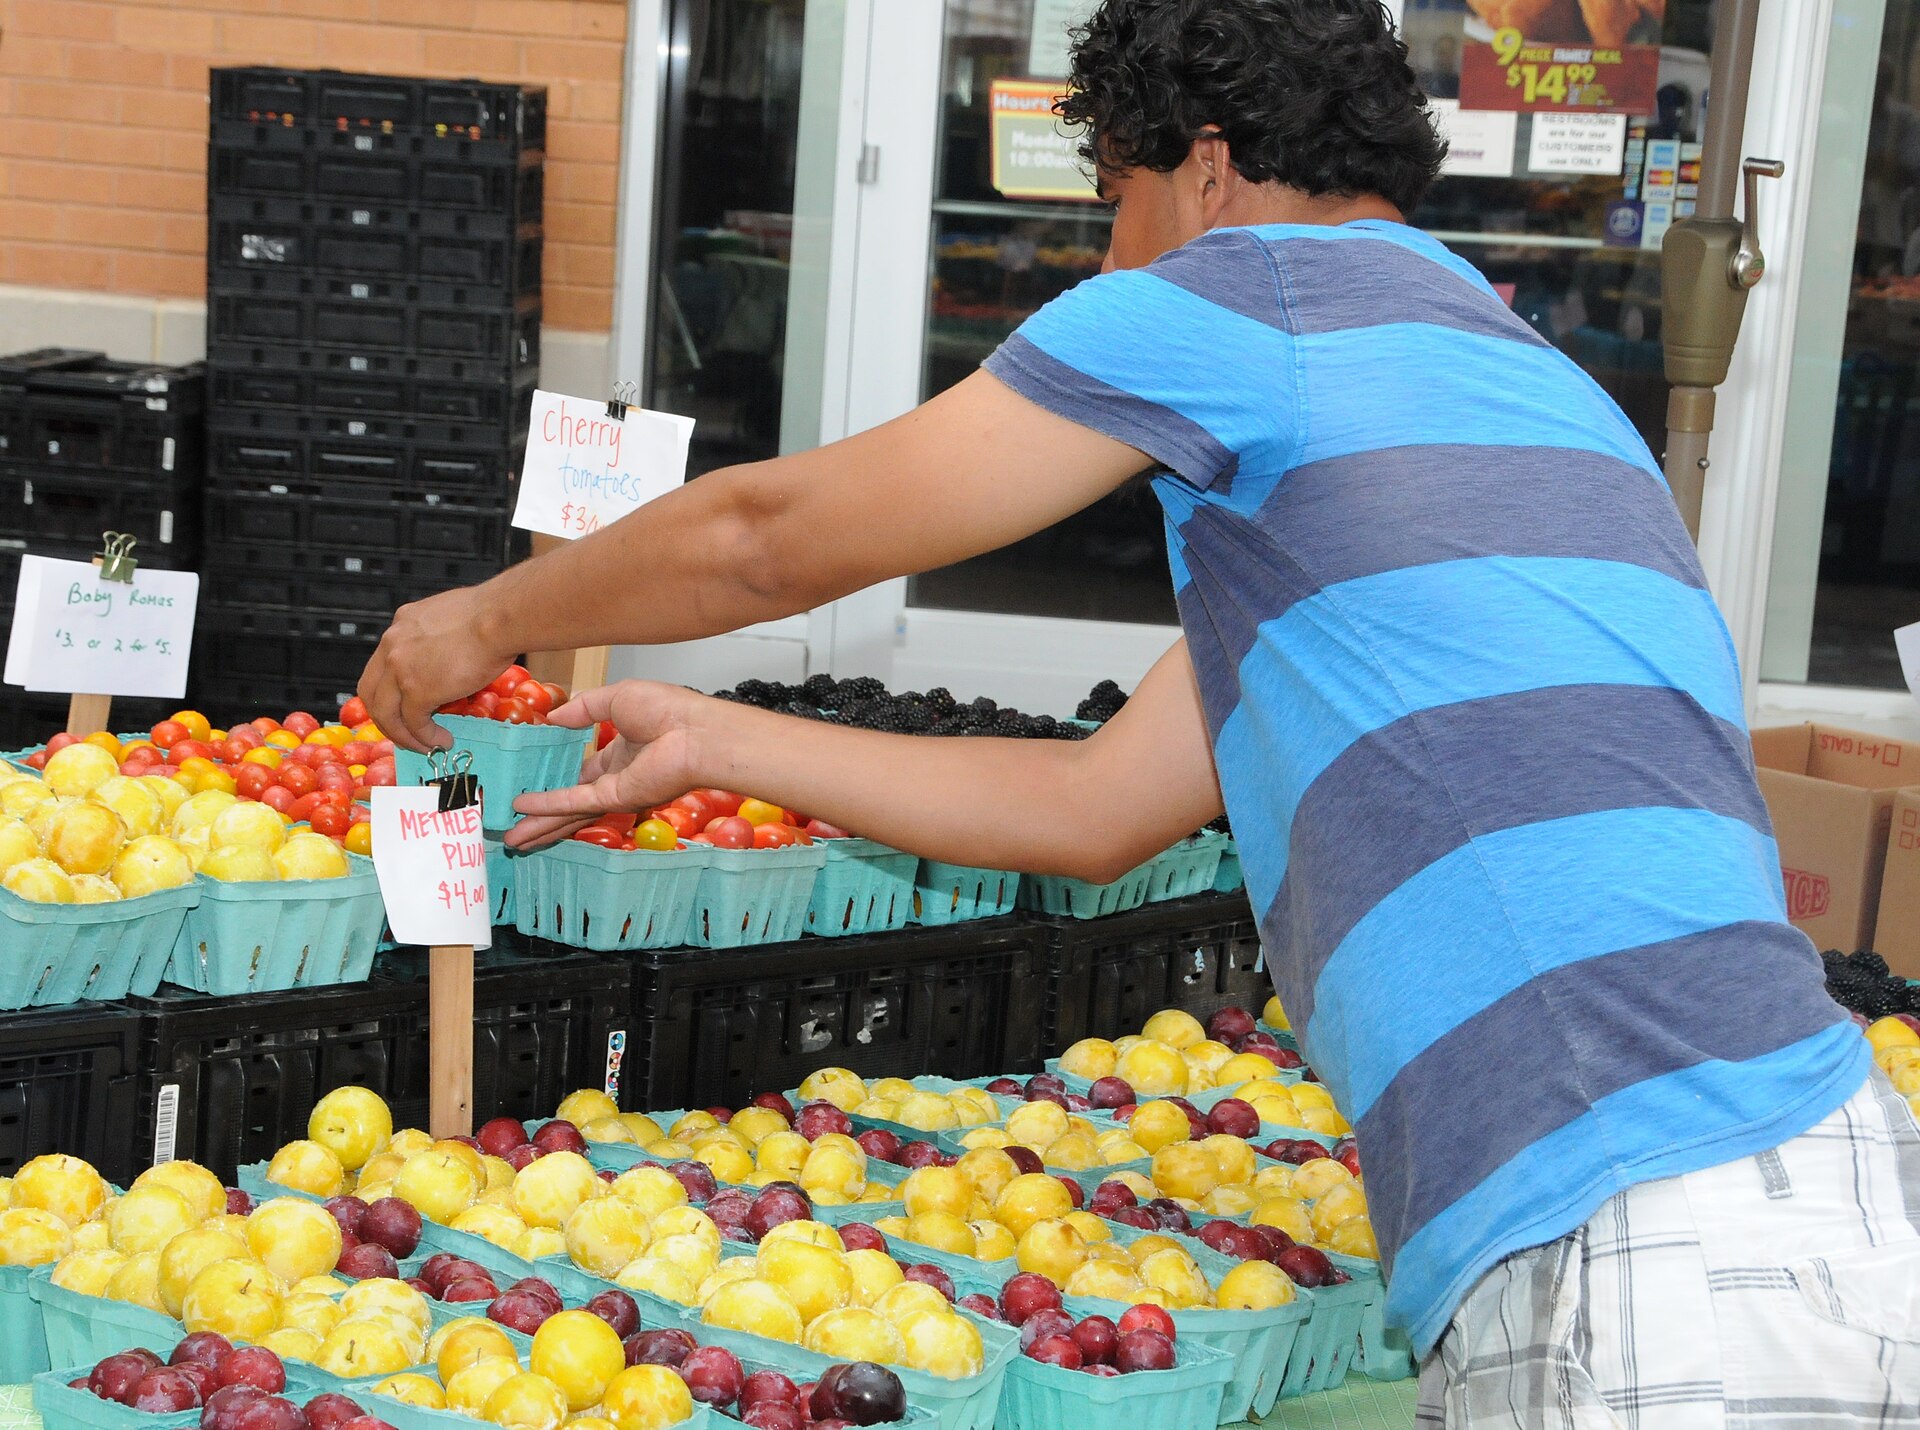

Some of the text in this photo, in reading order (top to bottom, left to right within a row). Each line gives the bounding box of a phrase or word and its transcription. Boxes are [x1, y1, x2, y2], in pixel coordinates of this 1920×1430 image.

[1492, 27, 1523, 65] 9
[993, 93, 1051, 111] Hours
[1538, 141, 1614, 153] CUSTOMERS
[1571, 156, 1602, 167] ONLY
[558, 453, 641, 501] tomatoes
[87, 639, 101, 649] or
[114, 638, 122, 652] 2
[438, 879, 485, 917] $4.00
